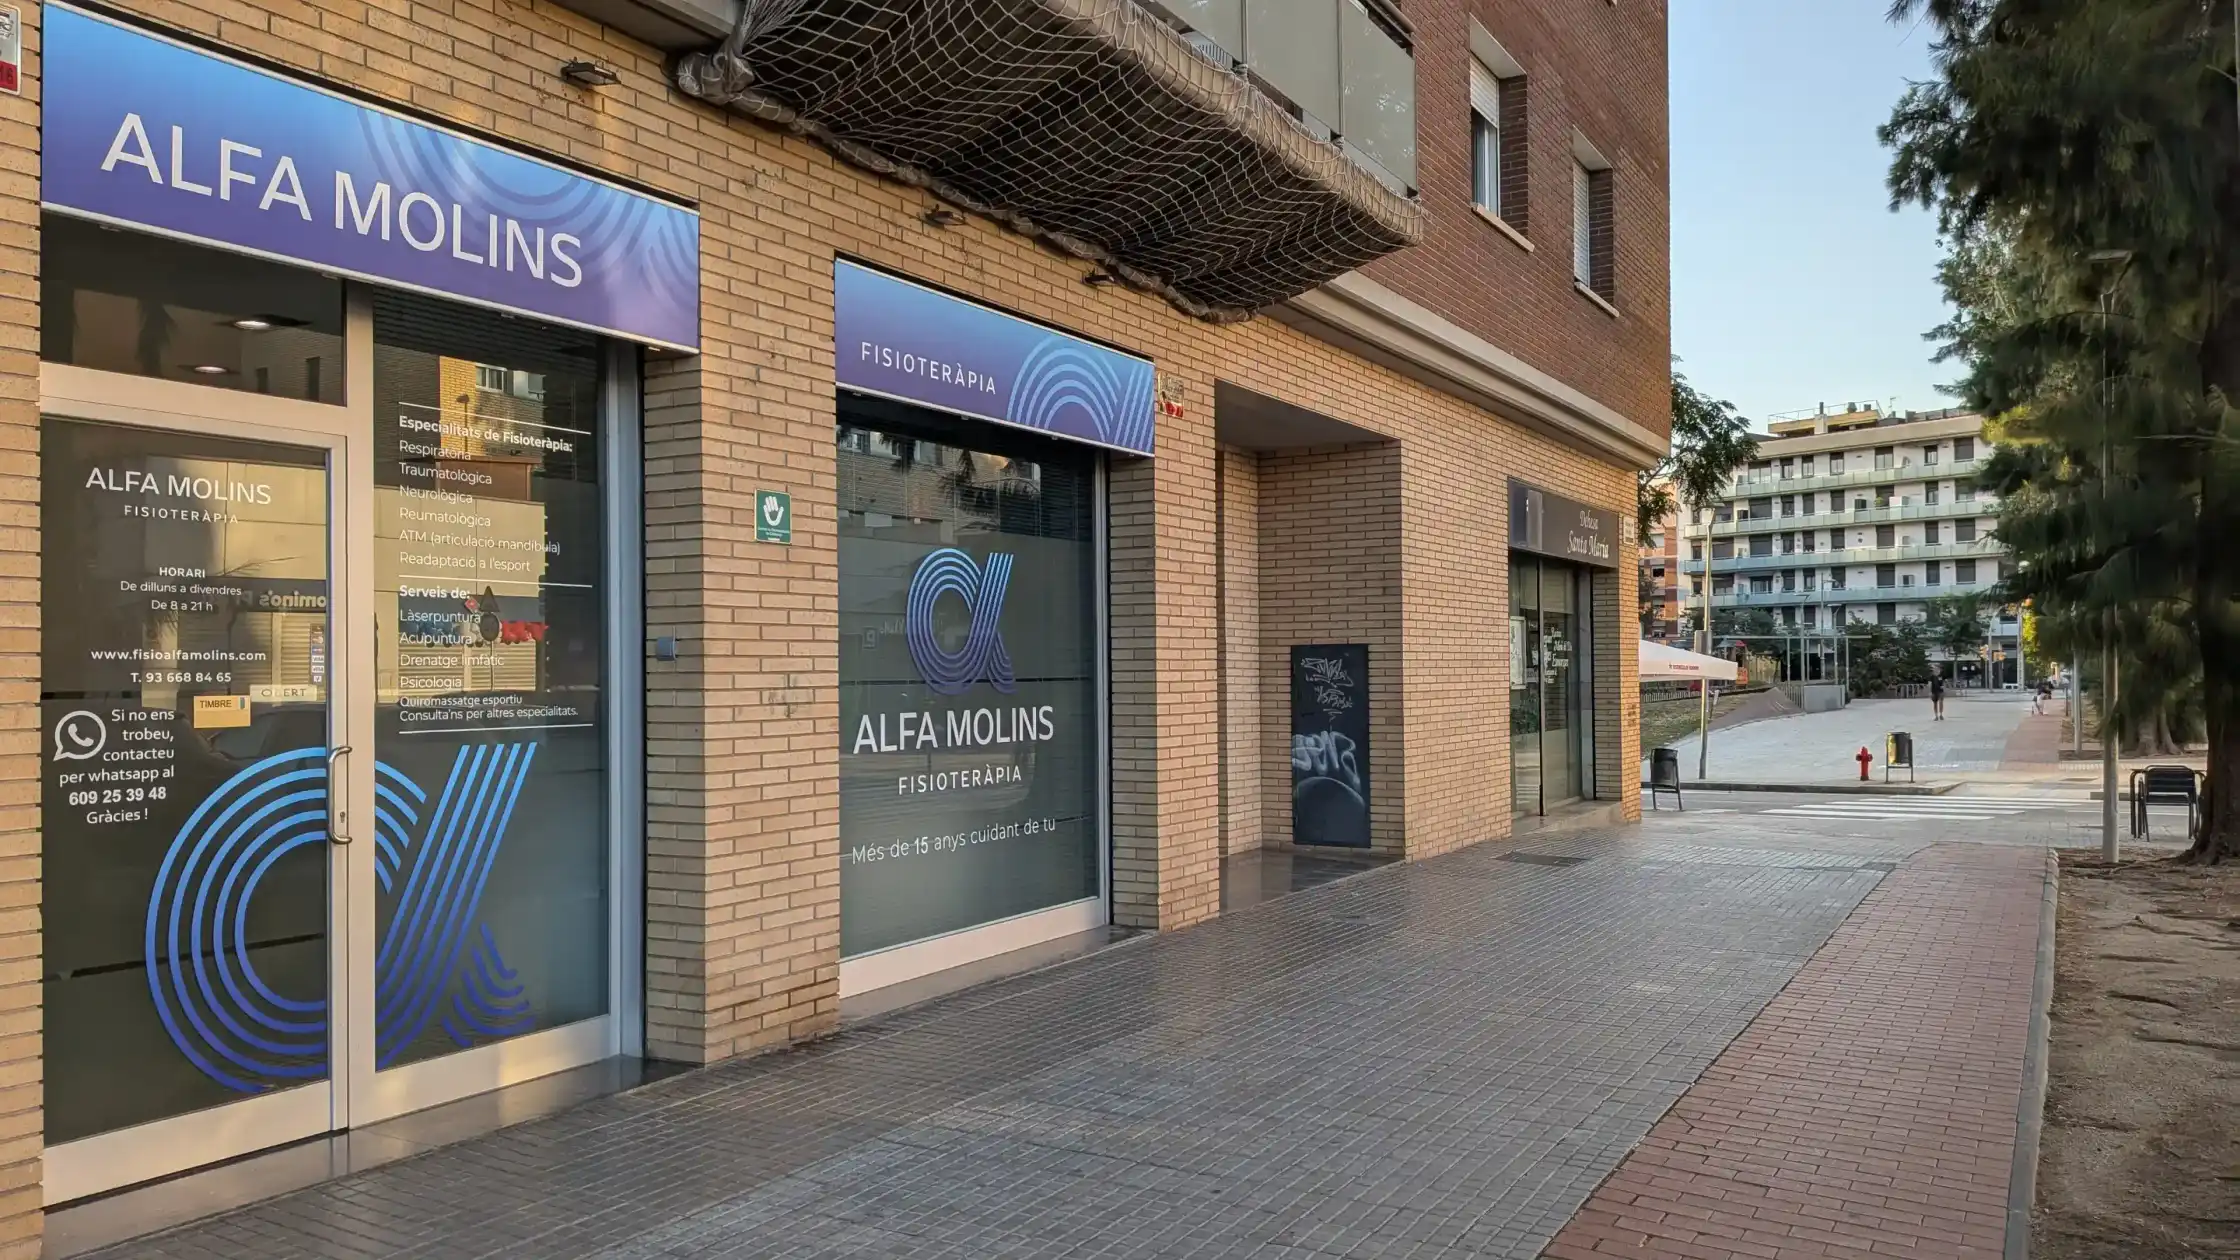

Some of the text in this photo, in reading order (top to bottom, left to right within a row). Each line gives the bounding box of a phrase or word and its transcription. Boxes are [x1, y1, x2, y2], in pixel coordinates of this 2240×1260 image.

[101, 112, 583, 288] ALFA MOLINS
[861, 341, 997, 395] FISIOTERÀPIA
[399, 415, 573, 453] Especialitats de Fisioteràpia:
[399, 439, 471, 461] Respiratòria
[399, 461, 493, 486] Traumatològica
[85, 467, 272, 505] ALFA MOLINS
[399, 485, 473, 505] Neurològica
[123, 504, 239, 525] FISIOTERÀPIA
[399, 507, 491, 528] Reumatològica
[399, 529, 427, 542] ATM
[430, 531, 495, 549] (articulació
[1566, 530, 1588, 555] Santa
[399, 551, 531, 572] Readaptació a l'esport
[158, 566, 206, 579] HORARI
[120, 580, 242, 597] De dilluns a divendres
[399, 584, 471, 600] Serveis de:
[151, 599, 213, 612] De 8 a 21 h
[399, 608, 482, 625] Làserpuntura
[399, 631, 473, 647] Acupuntura
[90, 649, 267, 662] www.fisioalfamolins.com
[399, 654, 458, 669] Drenatge
[130, 672, 232, 683] T. 93 668 84 65
[399, 676, 463, 691] Psicologia
[199, 699, 232, 709] TIMBRE
[399, 693, 523, 708] Quiromassatge esportiu
[111, 709, 175, 722] Si no ens
[399, 705, 579, 722] Consulta'ns per altres especialitats.
[122, 728, 175, 742] trobeu,
[852, 705, 1055, 755] ALFA MOLINS
[103, 749, 175, 762] contacteu
[59, 766, 175, 787] per whatsapp al
[898, 763, 1022, 796] FISIOTERÀPIA
[68, 786, 167, 806] 609 25 39 48
[86, 808, 149, 824] Gràcies !
[852, 816, 1057, 865] Més de 15 anys cuidant de tu
